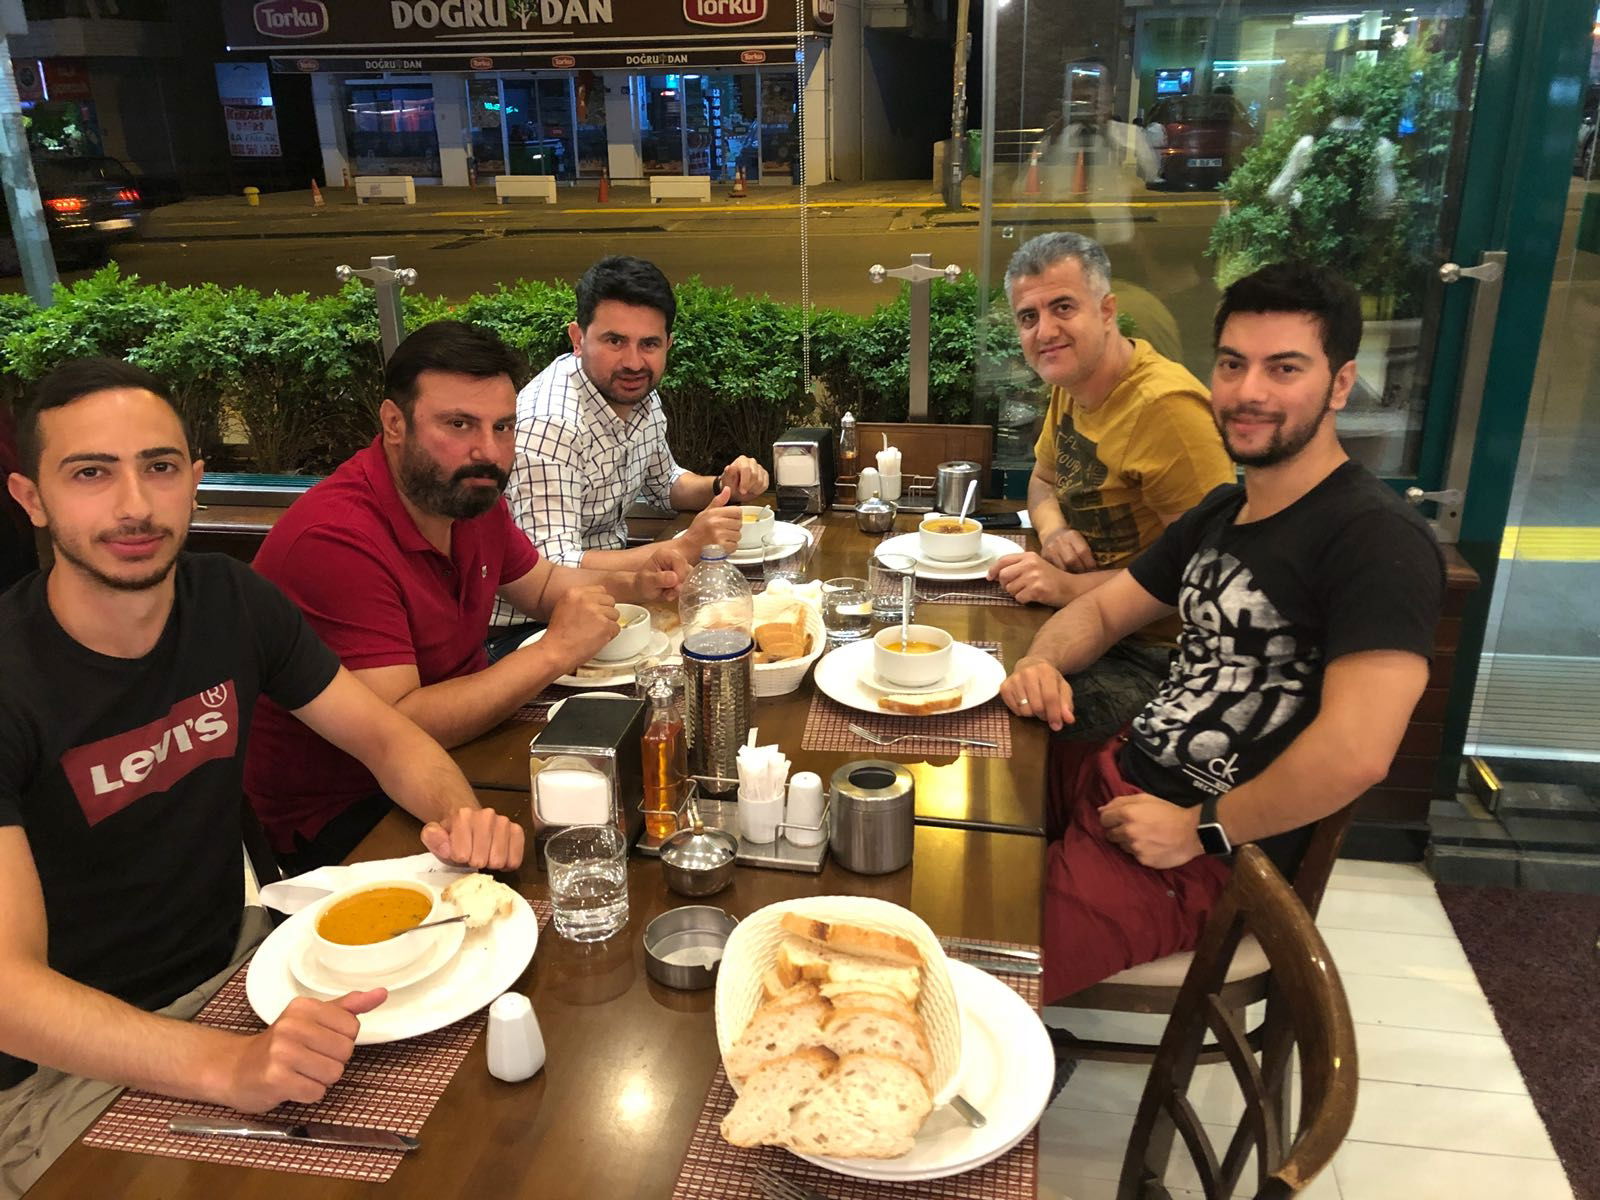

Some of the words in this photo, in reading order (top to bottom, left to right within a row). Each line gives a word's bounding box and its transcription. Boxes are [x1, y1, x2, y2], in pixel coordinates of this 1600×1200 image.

[261, 7, 318, 28] Torku
[540, 0, 613, 25] DAN
[403, 59, 422, 69] DAN
[667, 54, 689, 64] DAN
